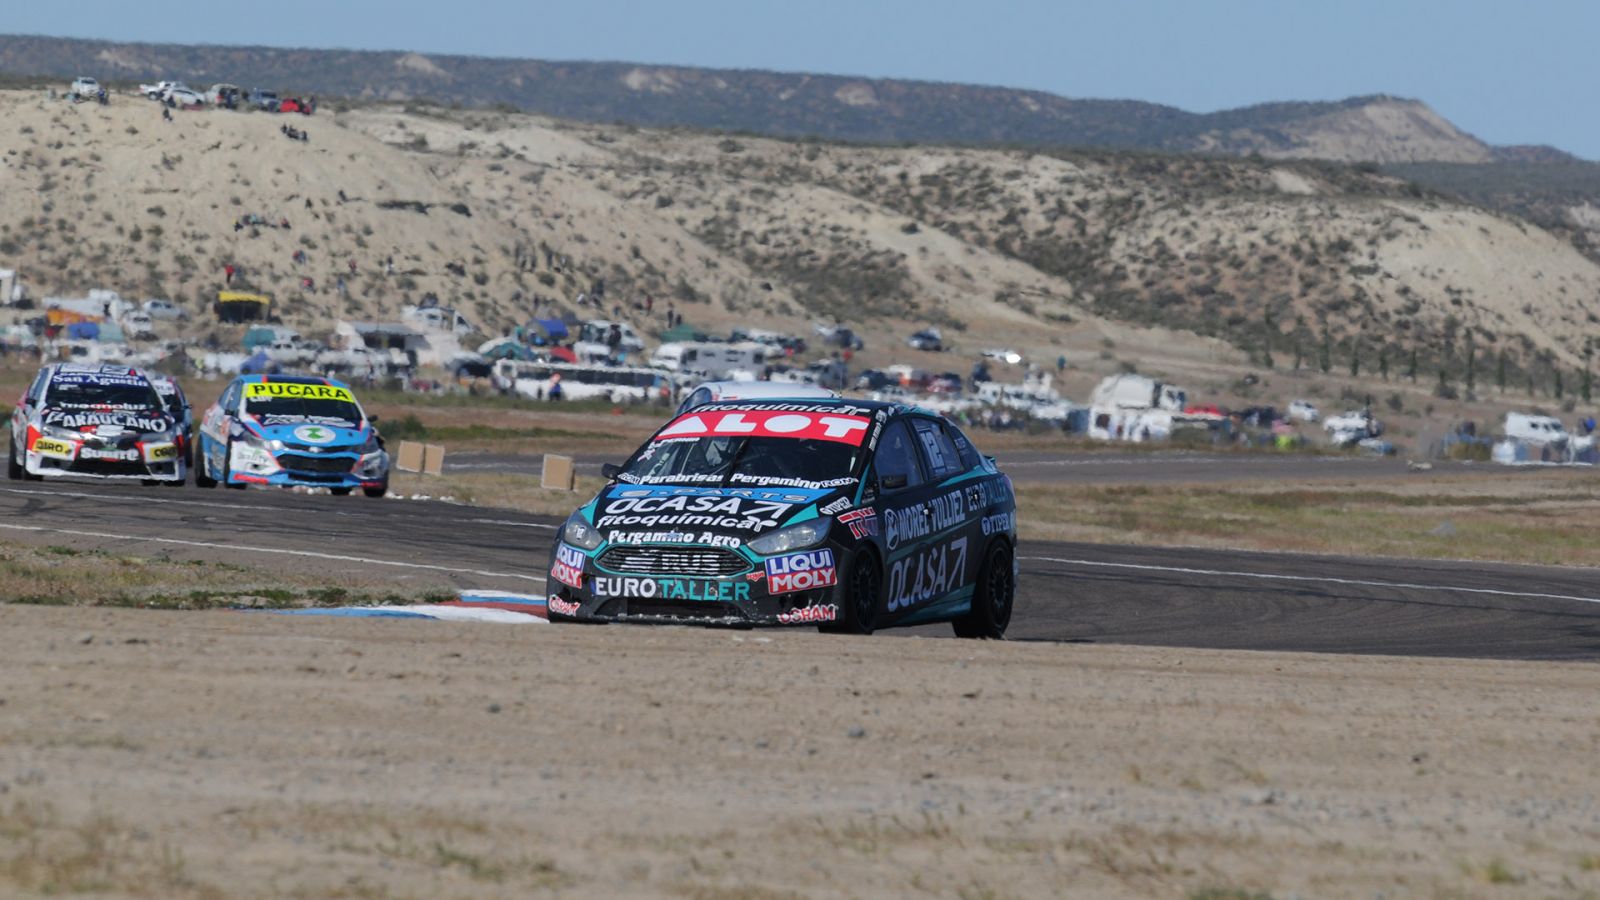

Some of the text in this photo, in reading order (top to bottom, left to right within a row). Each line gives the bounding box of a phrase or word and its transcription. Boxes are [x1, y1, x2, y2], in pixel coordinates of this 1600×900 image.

[252, 384, 349, 399] PUCARA
[62, 414, 167, 433] ARAUCANO
[658, 413, 869, 438] ALOT
[731, 473, 820, 489] Pergamino
[605, 496, 741, 514] OCASA
[608, 530, 741, 548] Pergamino Agro
[770, 551, 831, 574] LIQUI
[773, 568, 833, 592] MOLY
